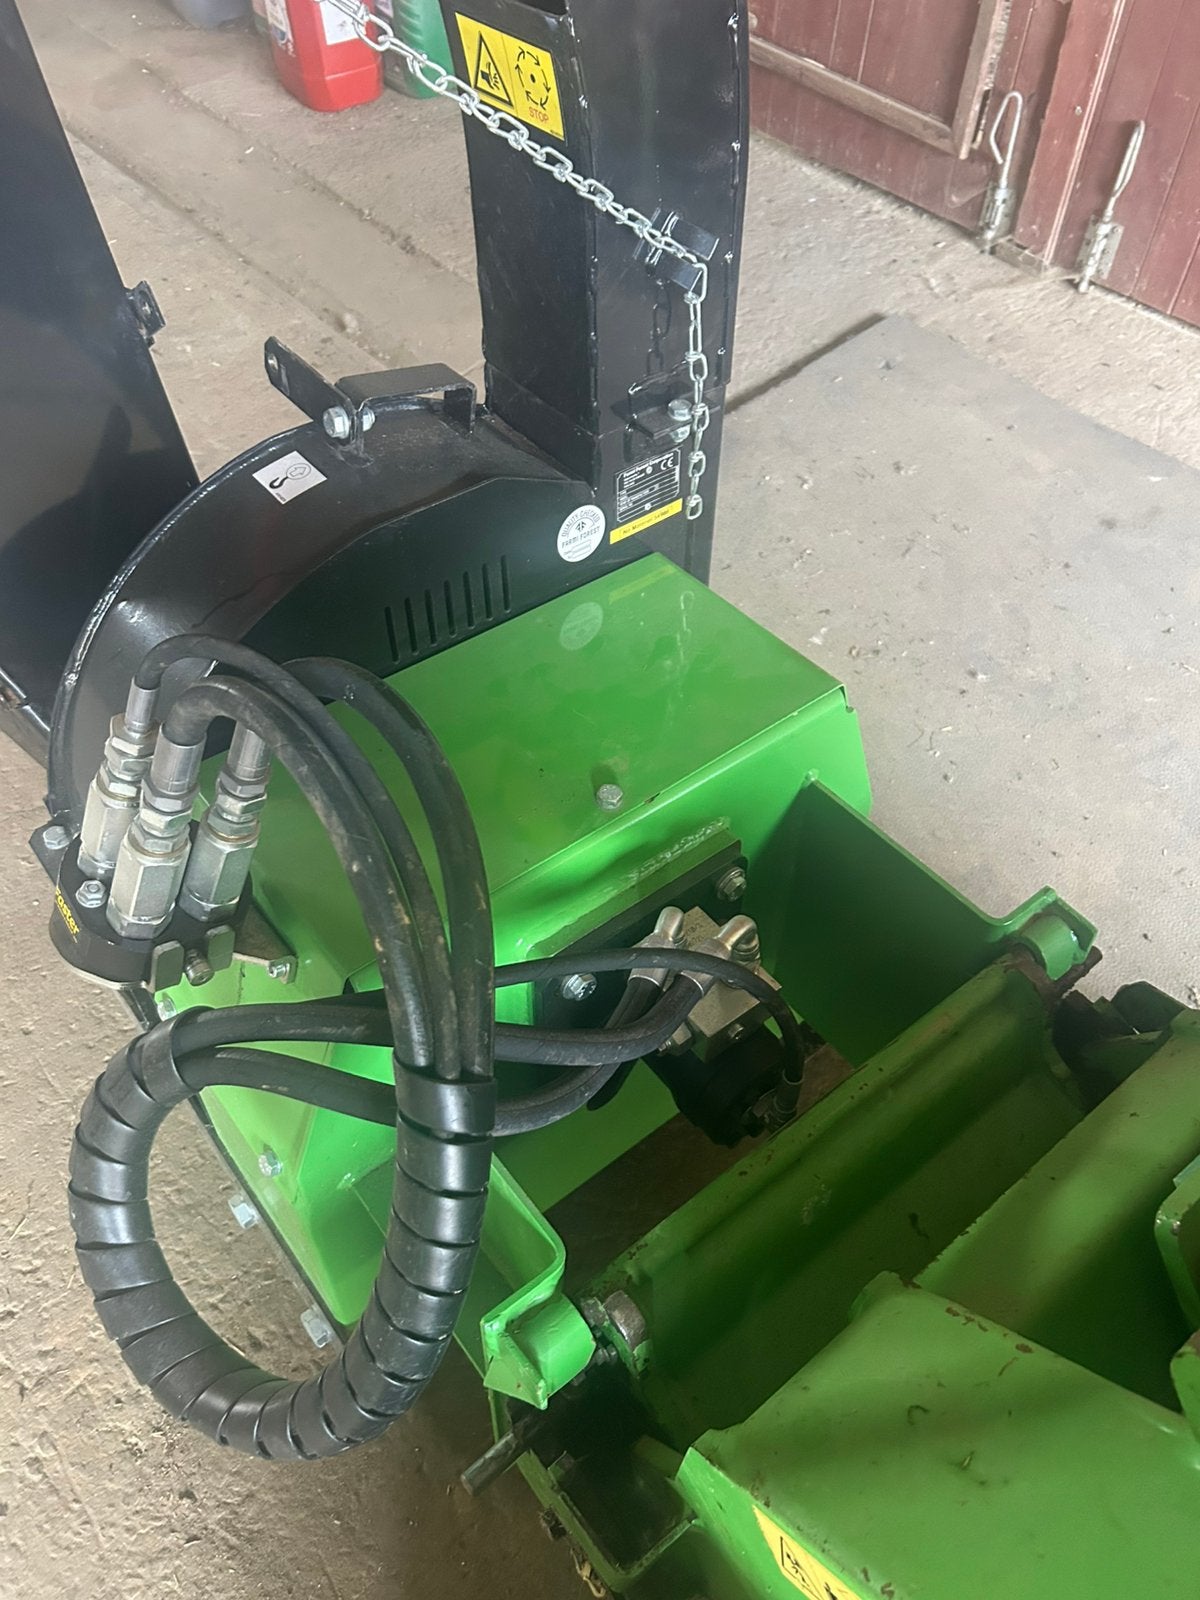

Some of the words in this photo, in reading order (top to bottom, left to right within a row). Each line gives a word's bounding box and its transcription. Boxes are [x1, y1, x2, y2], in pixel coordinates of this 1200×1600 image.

[529, 106, 549, 123] STOP
[660, 456, 674, 470] CE
[561, 514, 579, 537] QUALITY
[580, 509, 601, 523] CHECKED
[561, 536, 579, 549] FARMI
[580, 525, 600, 540] FOREST
